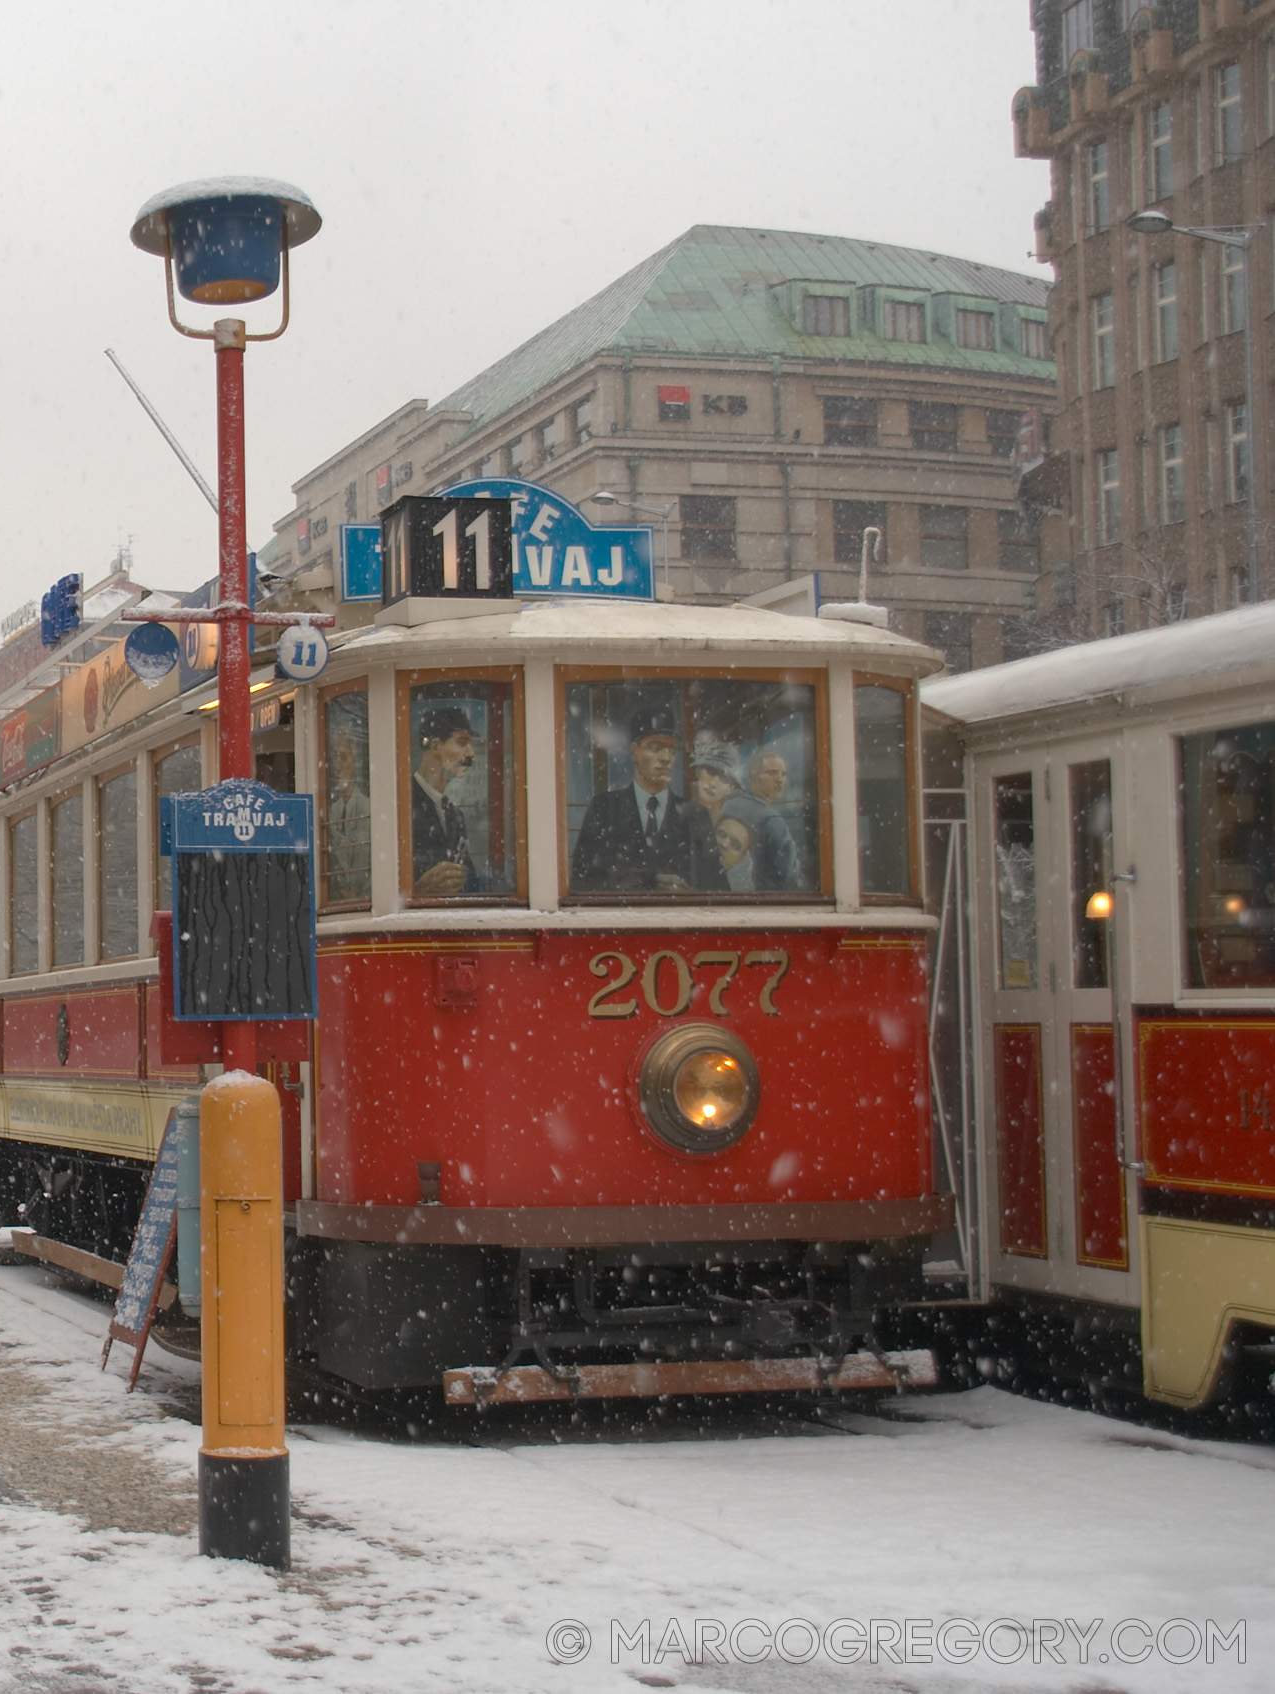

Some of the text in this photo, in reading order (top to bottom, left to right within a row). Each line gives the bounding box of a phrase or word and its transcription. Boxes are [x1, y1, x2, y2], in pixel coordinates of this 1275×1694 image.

[702, 395, 748, 415] KB
[388, 510, 406, 598] 11
[432, 507, 491, 590] 11
[291, 641, 317, 667] 11
[223, 793, 265, 811] CAFE
[202, 807, 285, 826] TRAMVAJ
[239, 825, 249, 836] 11
[588, 950, 790, 1017] 2077
